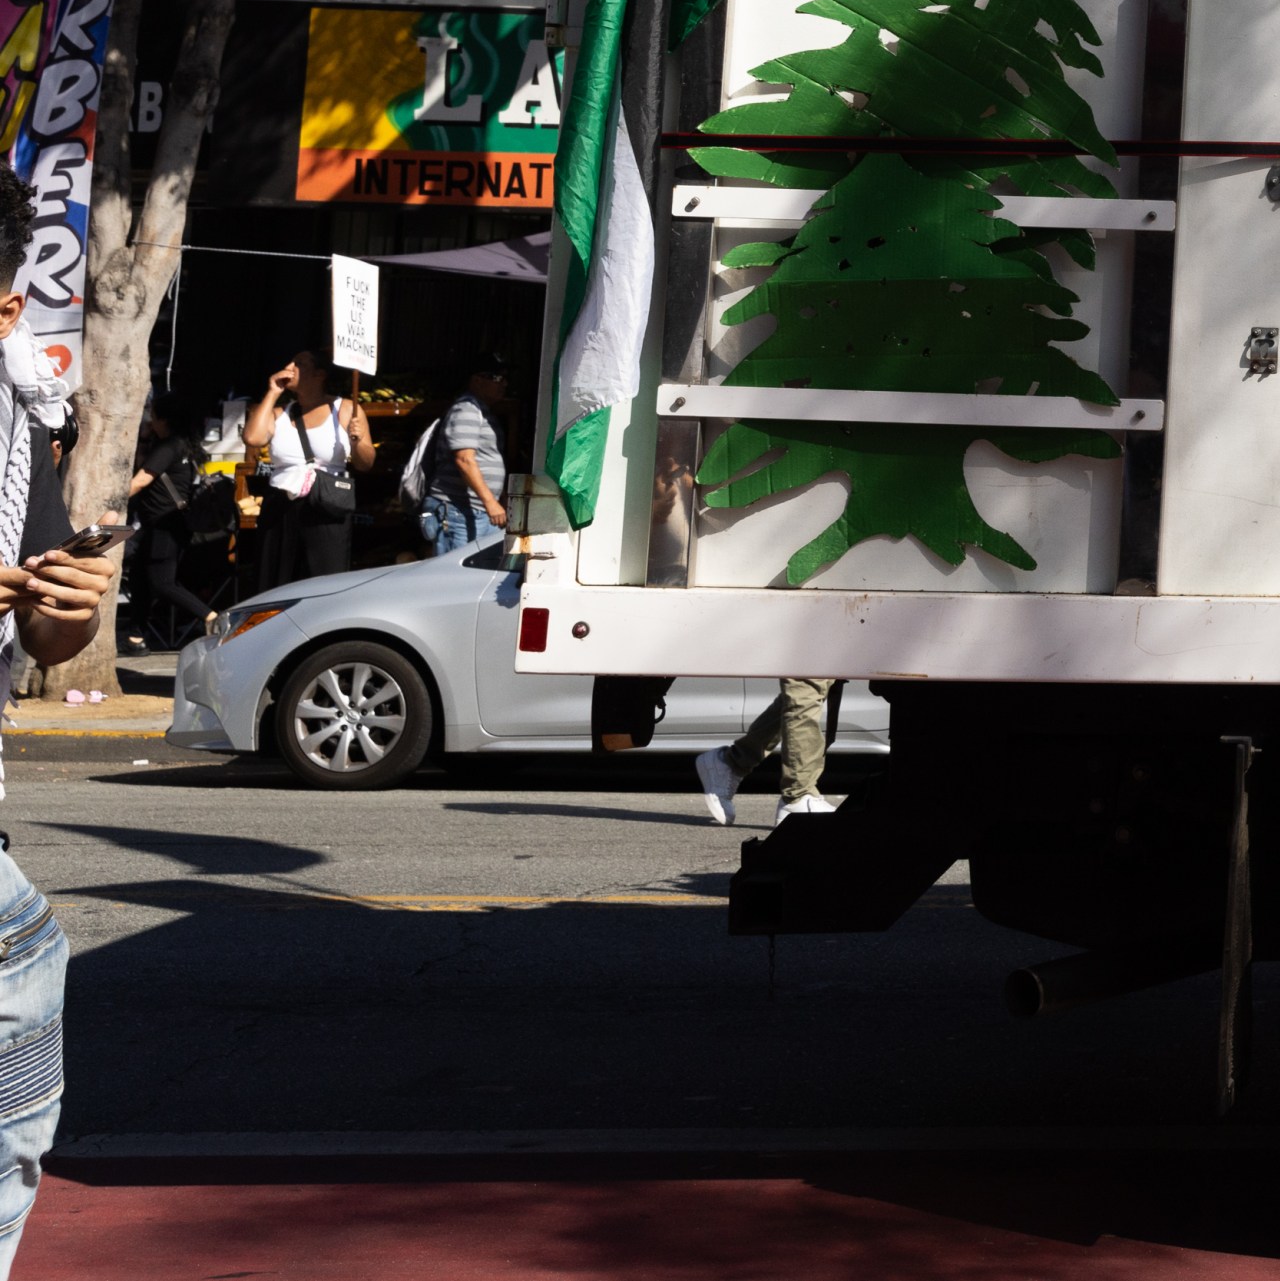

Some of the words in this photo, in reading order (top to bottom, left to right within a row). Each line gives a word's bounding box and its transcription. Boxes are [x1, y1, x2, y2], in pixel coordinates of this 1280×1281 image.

[354, 157, 552, 199] INTERNAT
[346, 276, 370, 296] FUCK
[351, 295, 365, 311] THE
[347, 323, 365, 340] WAR
[336, 335, 375, 358] MACHINE
